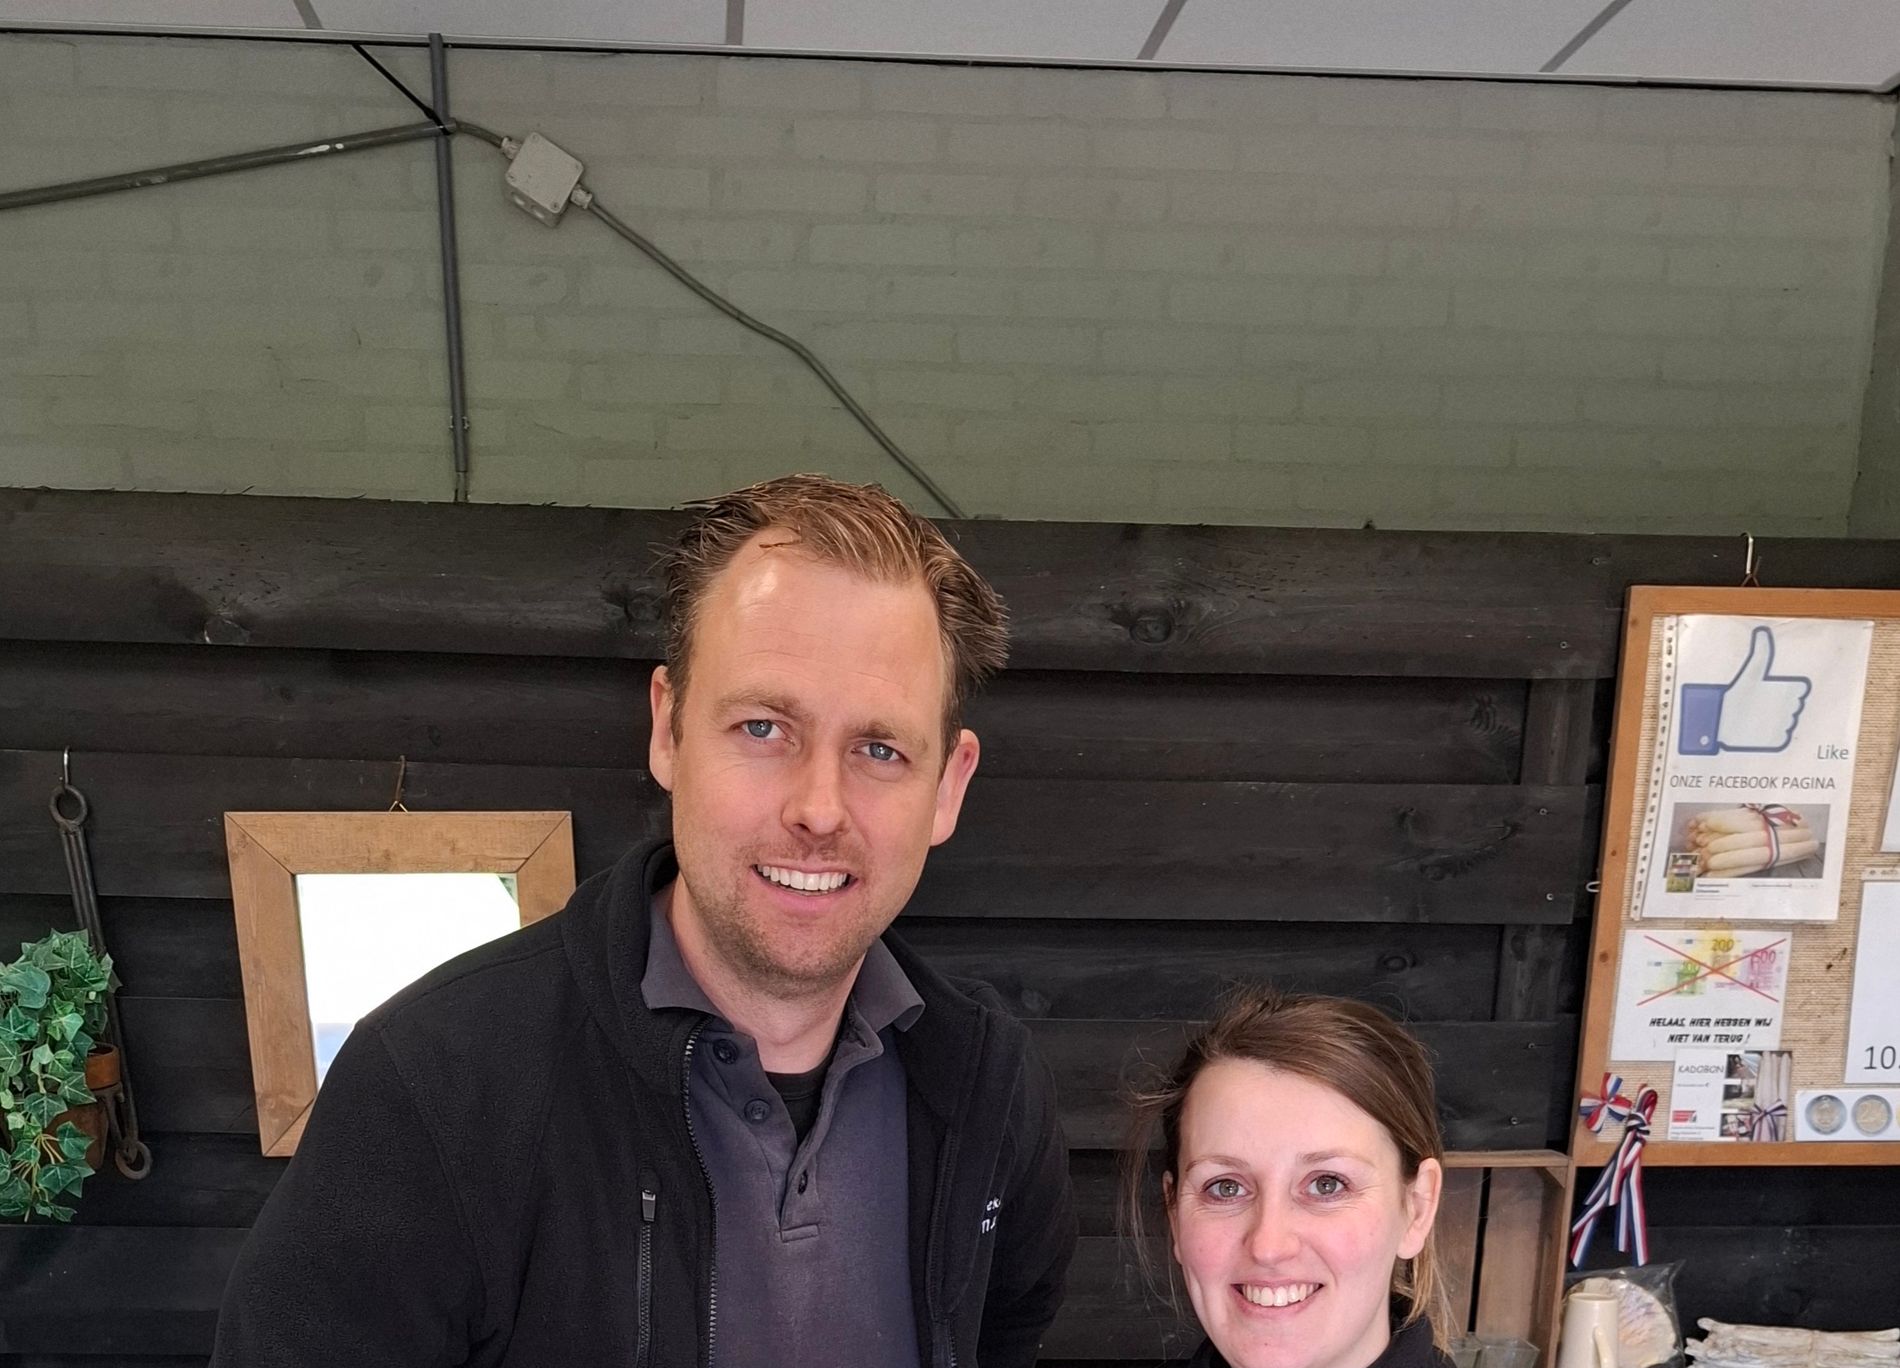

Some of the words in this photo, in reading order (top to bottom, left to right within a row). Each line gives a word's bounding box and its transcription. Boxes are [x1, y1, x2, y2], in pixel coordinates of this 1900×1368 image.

[1816, 744, 1849, 760] Like
[1669, 775, 1702, 788] ONZE
[1708, 776, 1779, 789] FACEBOOK
[1781, 776, 1836, 789] PAGINA
[1711, 938, 1735, 953] 200
[1689, 1018, 1711, 1028] HIER
[1714, 1018, 1751, 1027] HEBBEN
[1754, 1018, 1773, 1027] WIJ
[1667, 1034, 1690, 1043] NIET
[1692, 1034, 1710, 1043] VAN
[1713, 1034, 1743, 1043] TERUG
[1678, 1064, 1725, 1074] KADOBON
